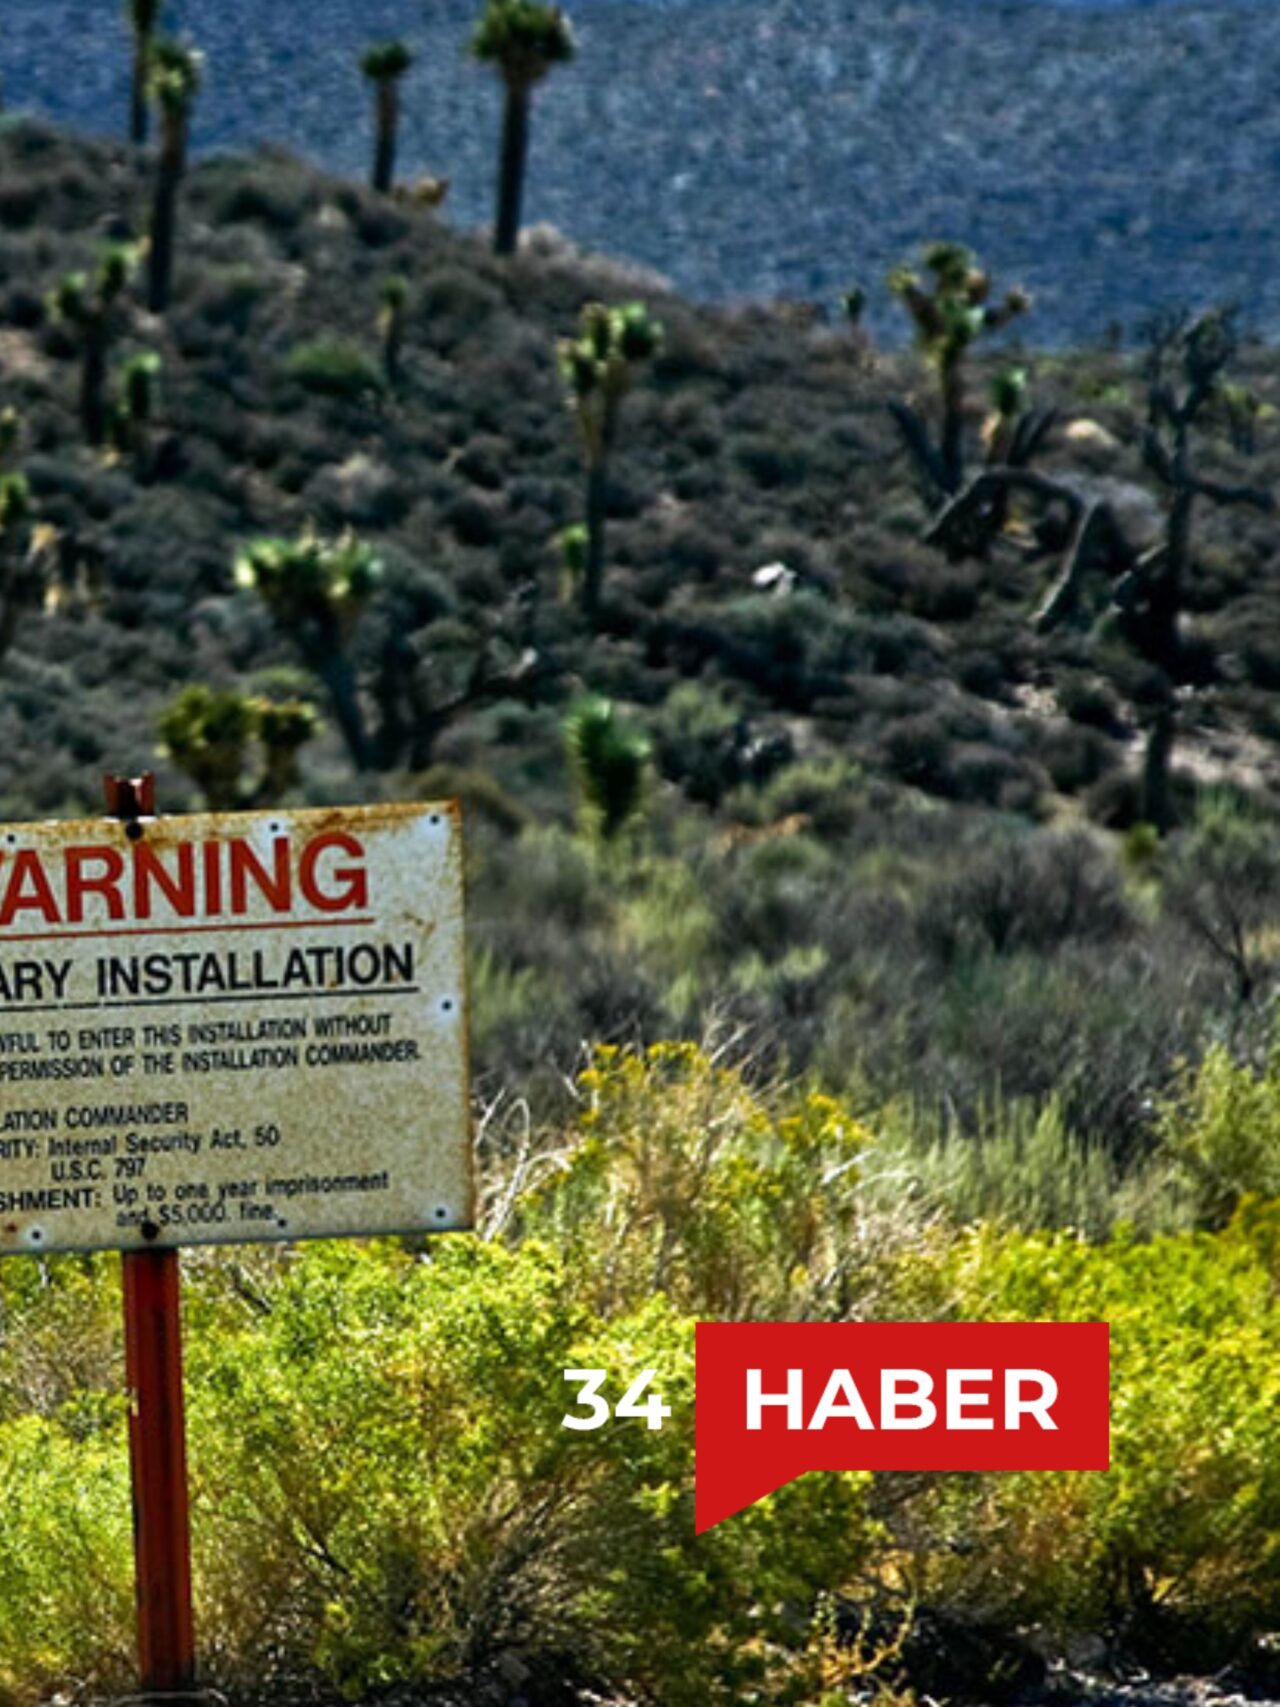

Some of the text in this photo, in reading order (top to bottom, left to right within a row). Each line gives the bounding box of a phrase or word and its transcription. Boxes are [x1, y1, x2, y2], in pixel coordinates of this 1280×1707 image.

[98, 942, 415, 998] INSTALLATION
[47, 1030, 71, 1051] TO
[78, 1027, 135, 1050] ENTER
[143, 1024, 182, 1047] THIS
[187, 1018, 307, 1045] INSTALLATION
[314, 1013, 392, 1038] WITHOUT
[110, 1055, 136, 1077] OF
[143, 1053, 175, 1075] THE
[181, 1046, 299, 1073] INSTALLATION
[64, 1102, 189, 1129] COMMANDER
[48, 1135, 118, 1157] Internal
[125, 1130, 202, 1154] Security
[254, 1125, 281, 1147] 50
[114, 1156, 146, 1178] 797
[113, 1183, 139, 1207] Up
[147, 1182, 166, 1201] to
[175, 1182, 210, 1200] one
[218, 1178, 257, 1202] year
[265, 1170, 389, 1199] imprisonment
[115, 1205, 150, 1228] and
